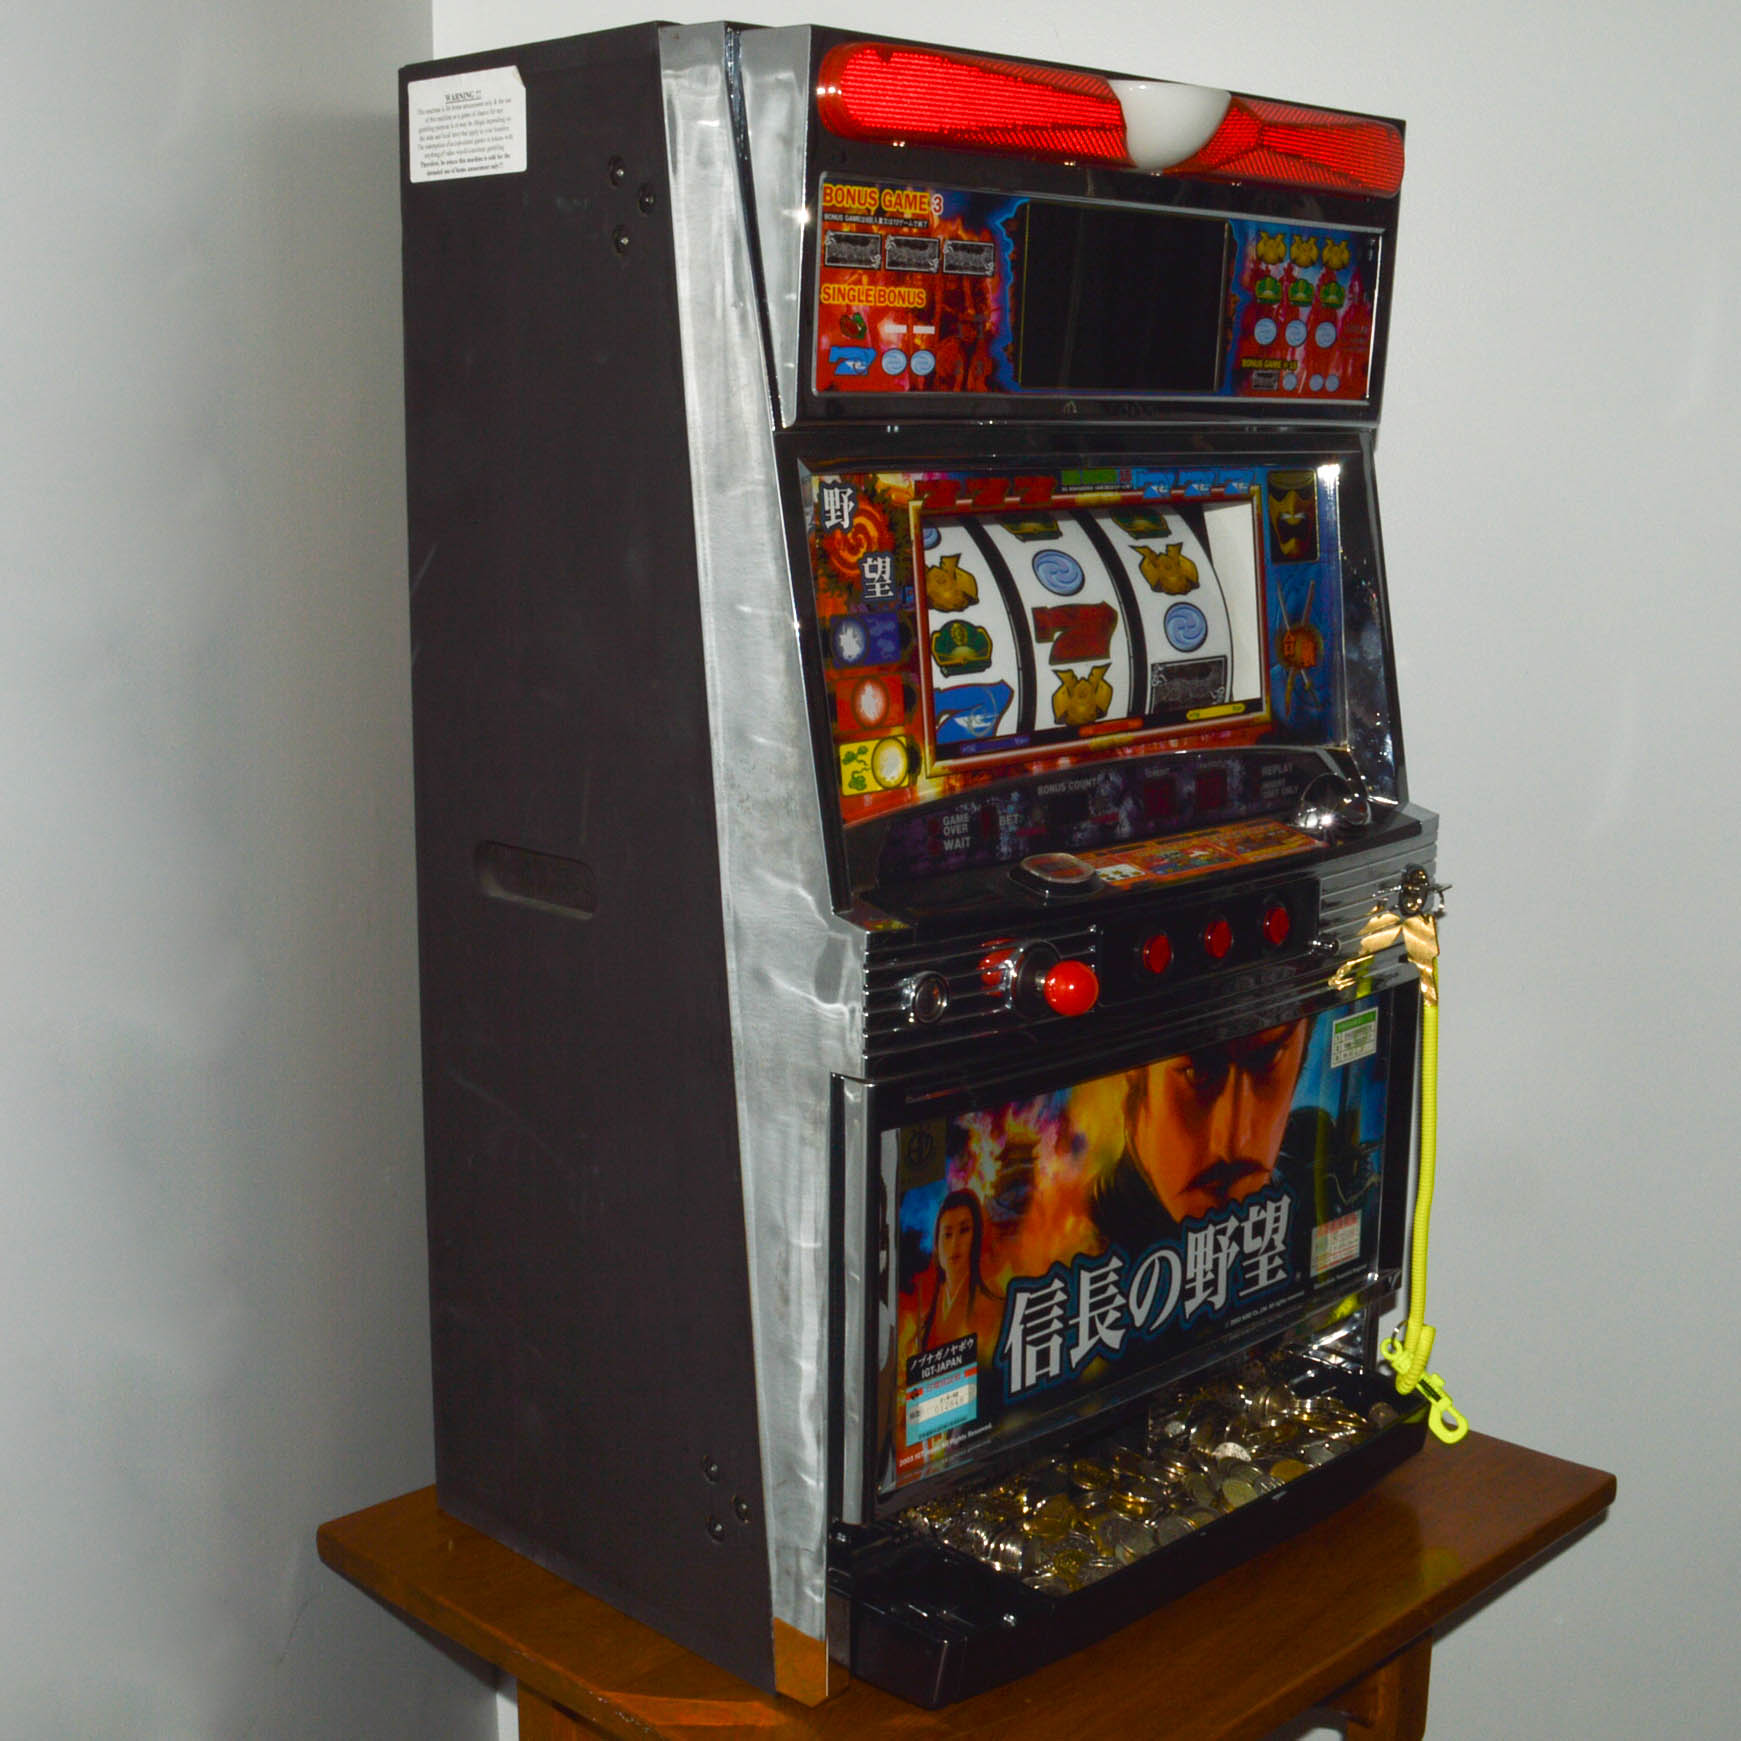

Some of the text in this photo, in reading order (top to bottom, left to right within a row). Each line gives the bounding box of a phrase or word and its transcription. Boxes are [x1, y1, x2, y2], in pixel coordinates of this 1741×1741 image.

[823, 184, 944, 215] BONUS GAME 3
[821, 284, 926, 308] SINGLE BONUS
[822, 486, 854, 530] 野
[861, 554, 893, 600] 望
[1037, 783, 1067, 796] BONUS
[943, 815, 970, 827] GAME
[943, 823, 969, 836] OVER
[943, 837, 972, 851] WAIT
[1004, 1193, 1292, 1394] 信長の野望
